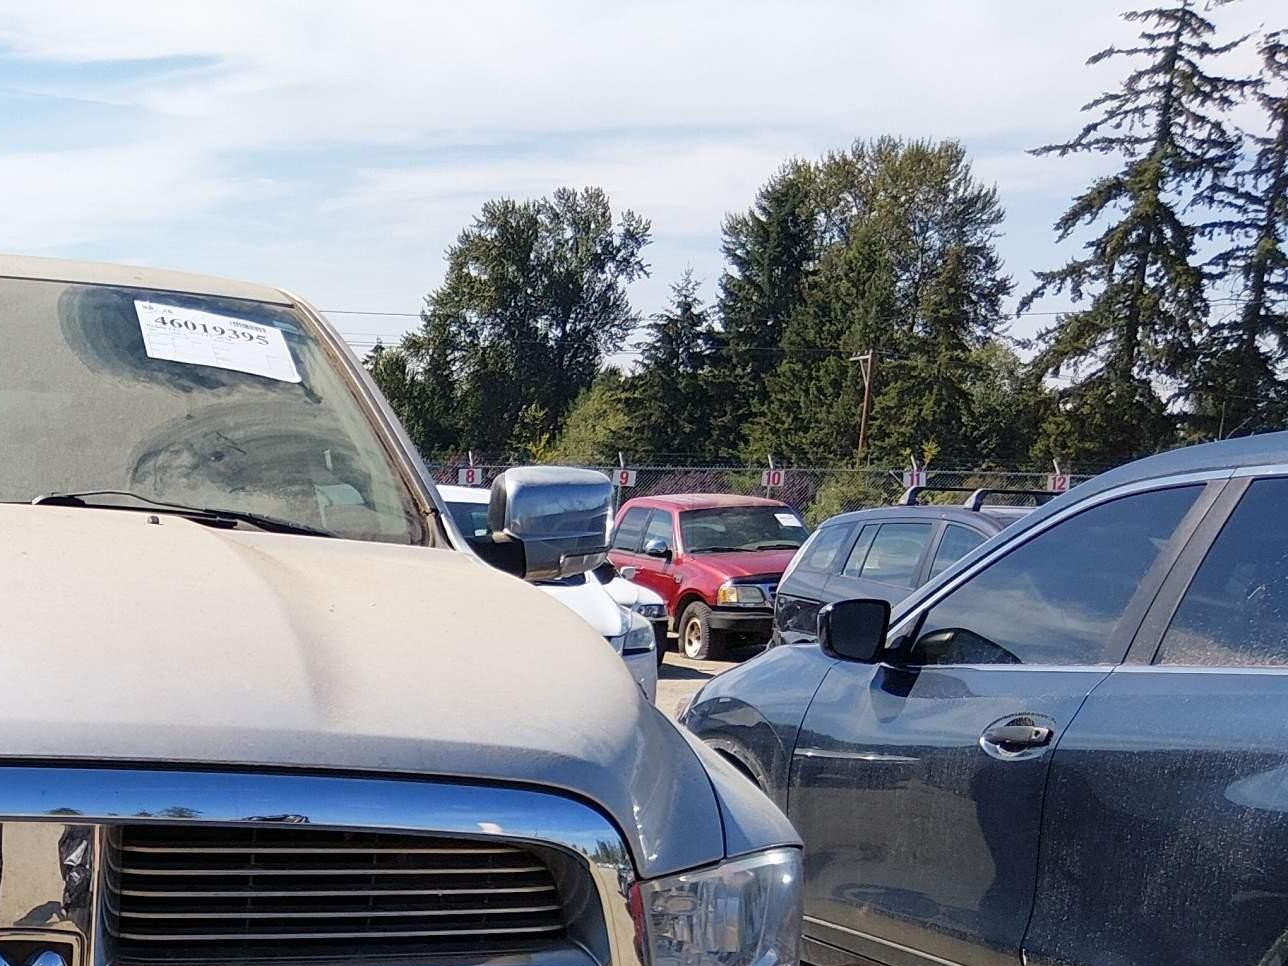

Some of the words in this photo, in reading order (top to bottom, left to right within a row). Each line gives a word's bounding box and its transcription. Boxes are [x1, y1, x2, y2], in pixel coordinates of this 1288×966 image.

[154, 316, 269, 345] 46019395
[465, 469, 475, 485] 8
[619, 470, 629, 486] 9
[766, 471, 782, 486] 10
[909, 472, 921, 486] 11
[1052, 476, 1066, 490] 12
